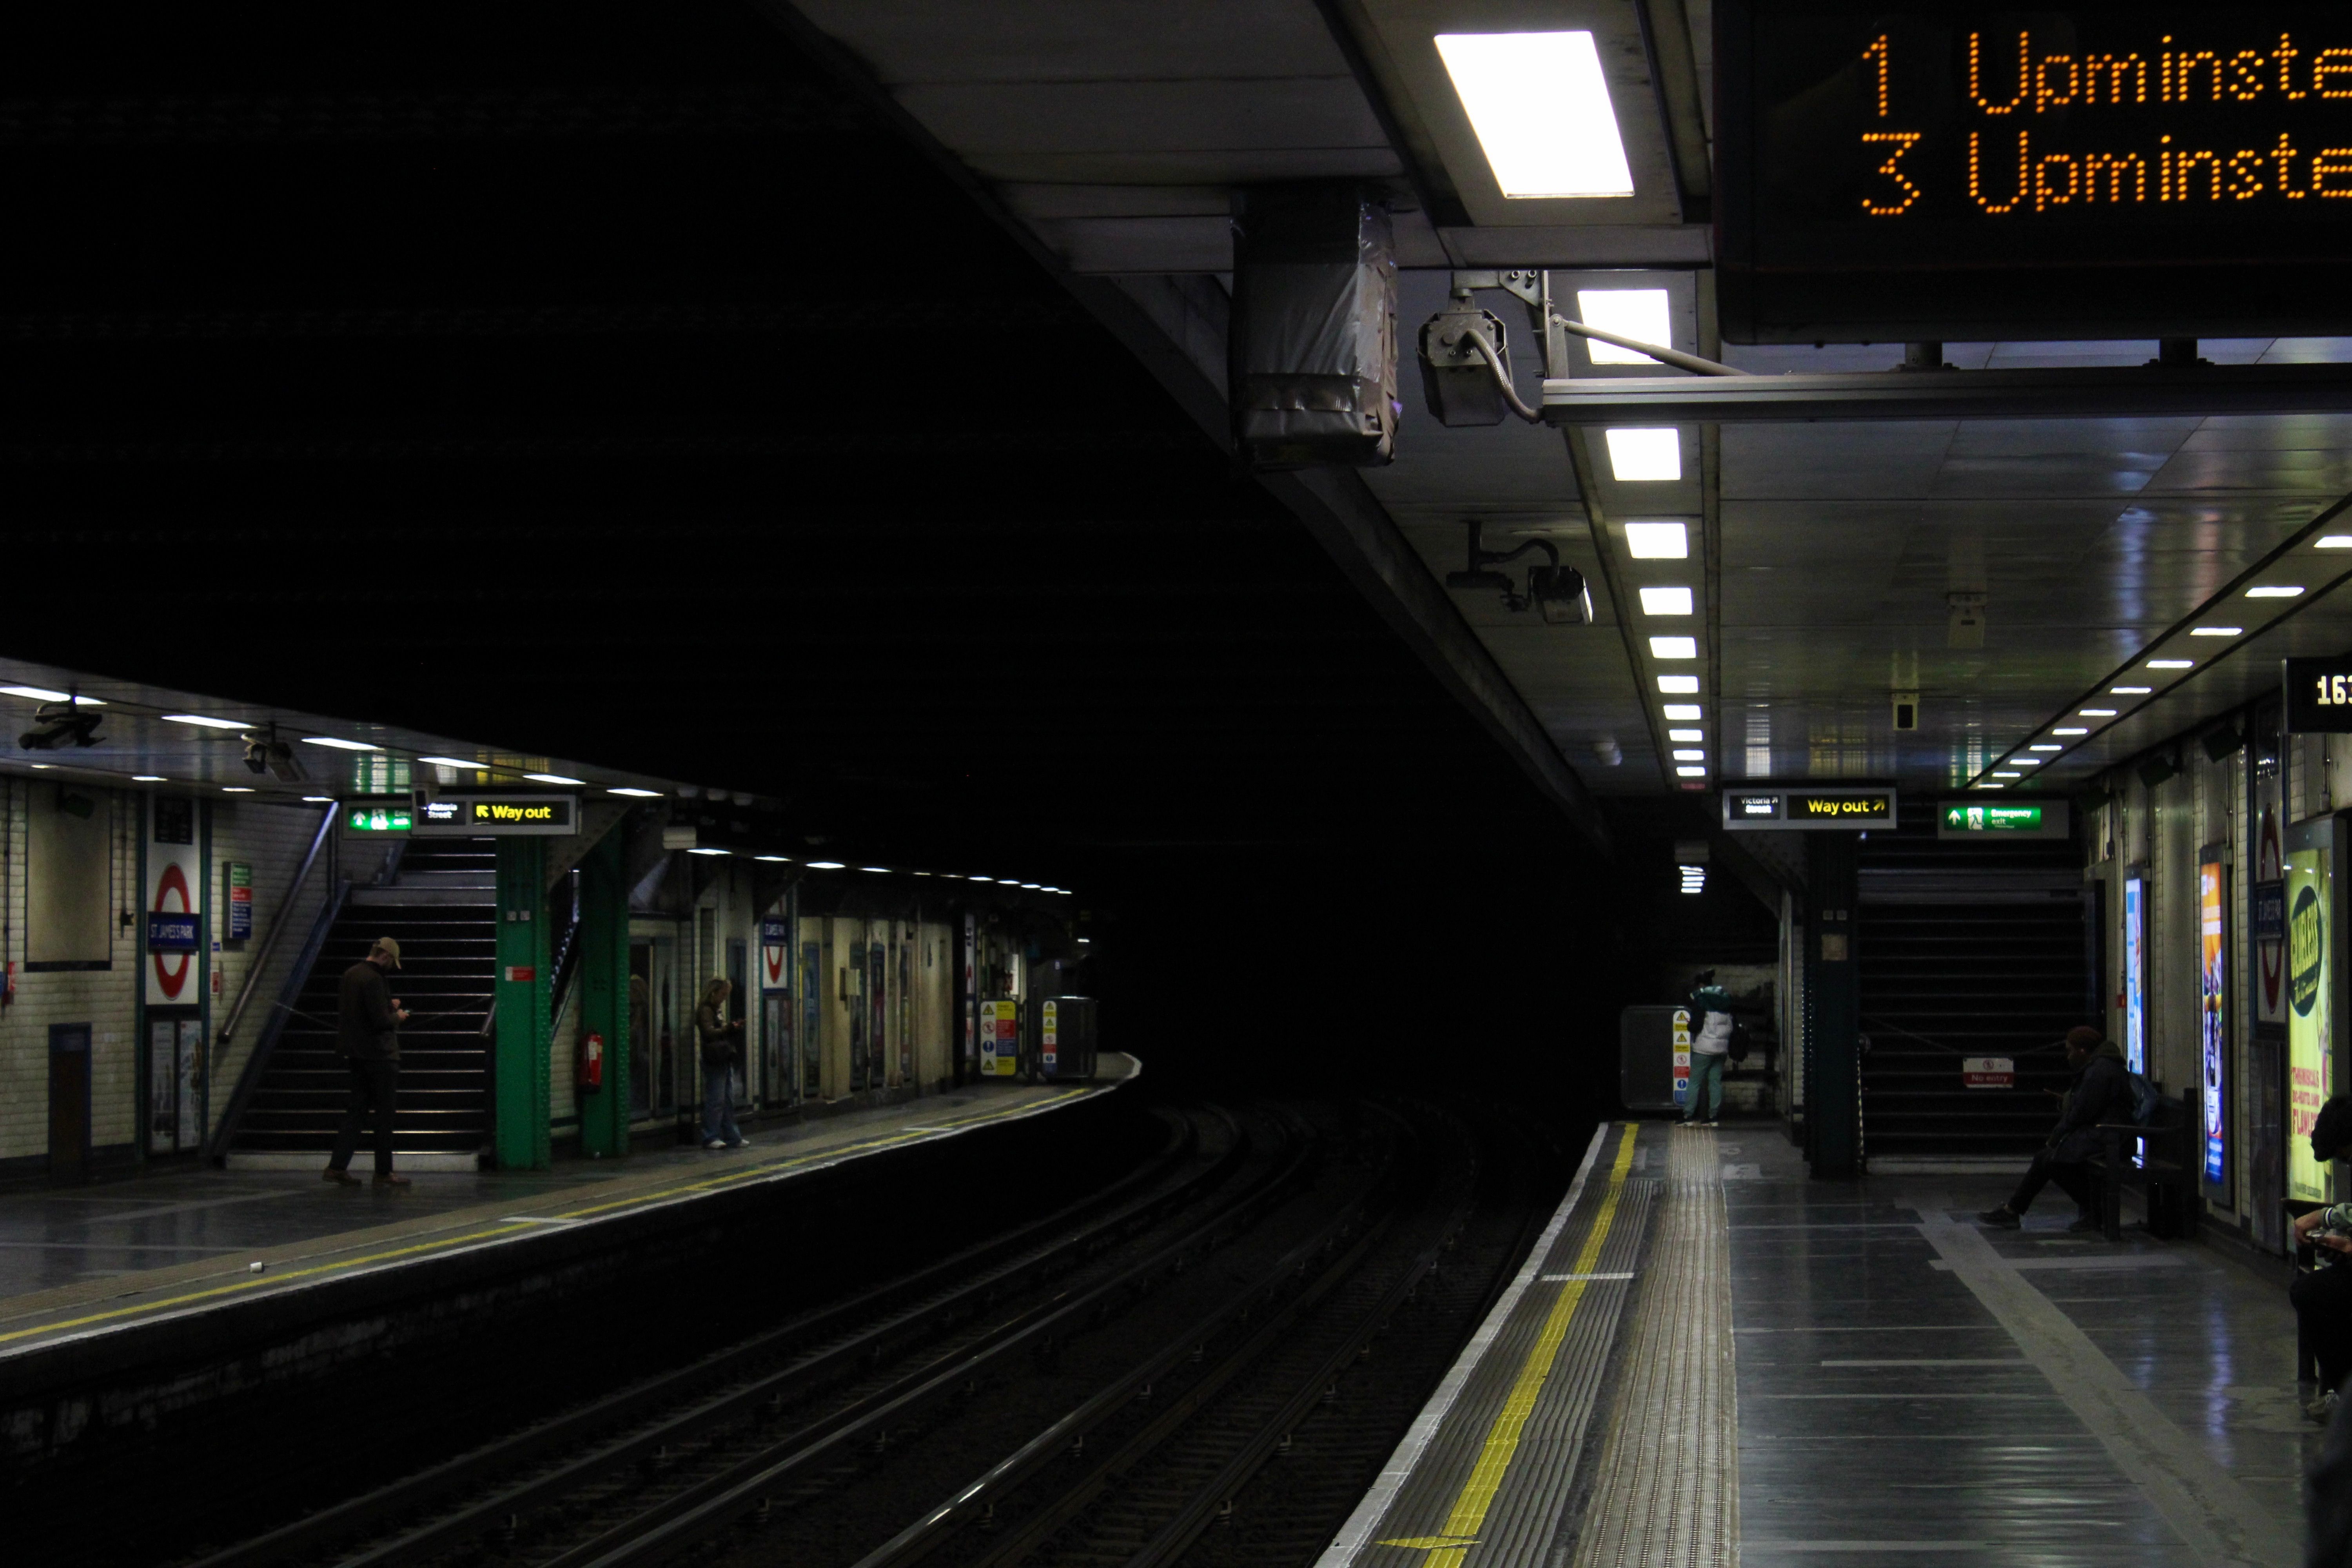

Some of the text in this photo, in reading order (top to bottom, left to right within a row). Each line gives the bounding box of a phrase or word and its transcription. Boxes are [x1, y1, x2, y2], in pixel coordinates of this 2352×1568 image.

[1863, 31, 2352, 116] 1 Upminste
[1862, 131, 2352, 215] 3 Upminste
[492, 805, 551, 821] Way out
[1808, 800, 1869, 815] Way out
[1991, 809, 2031, 818] Emergency
